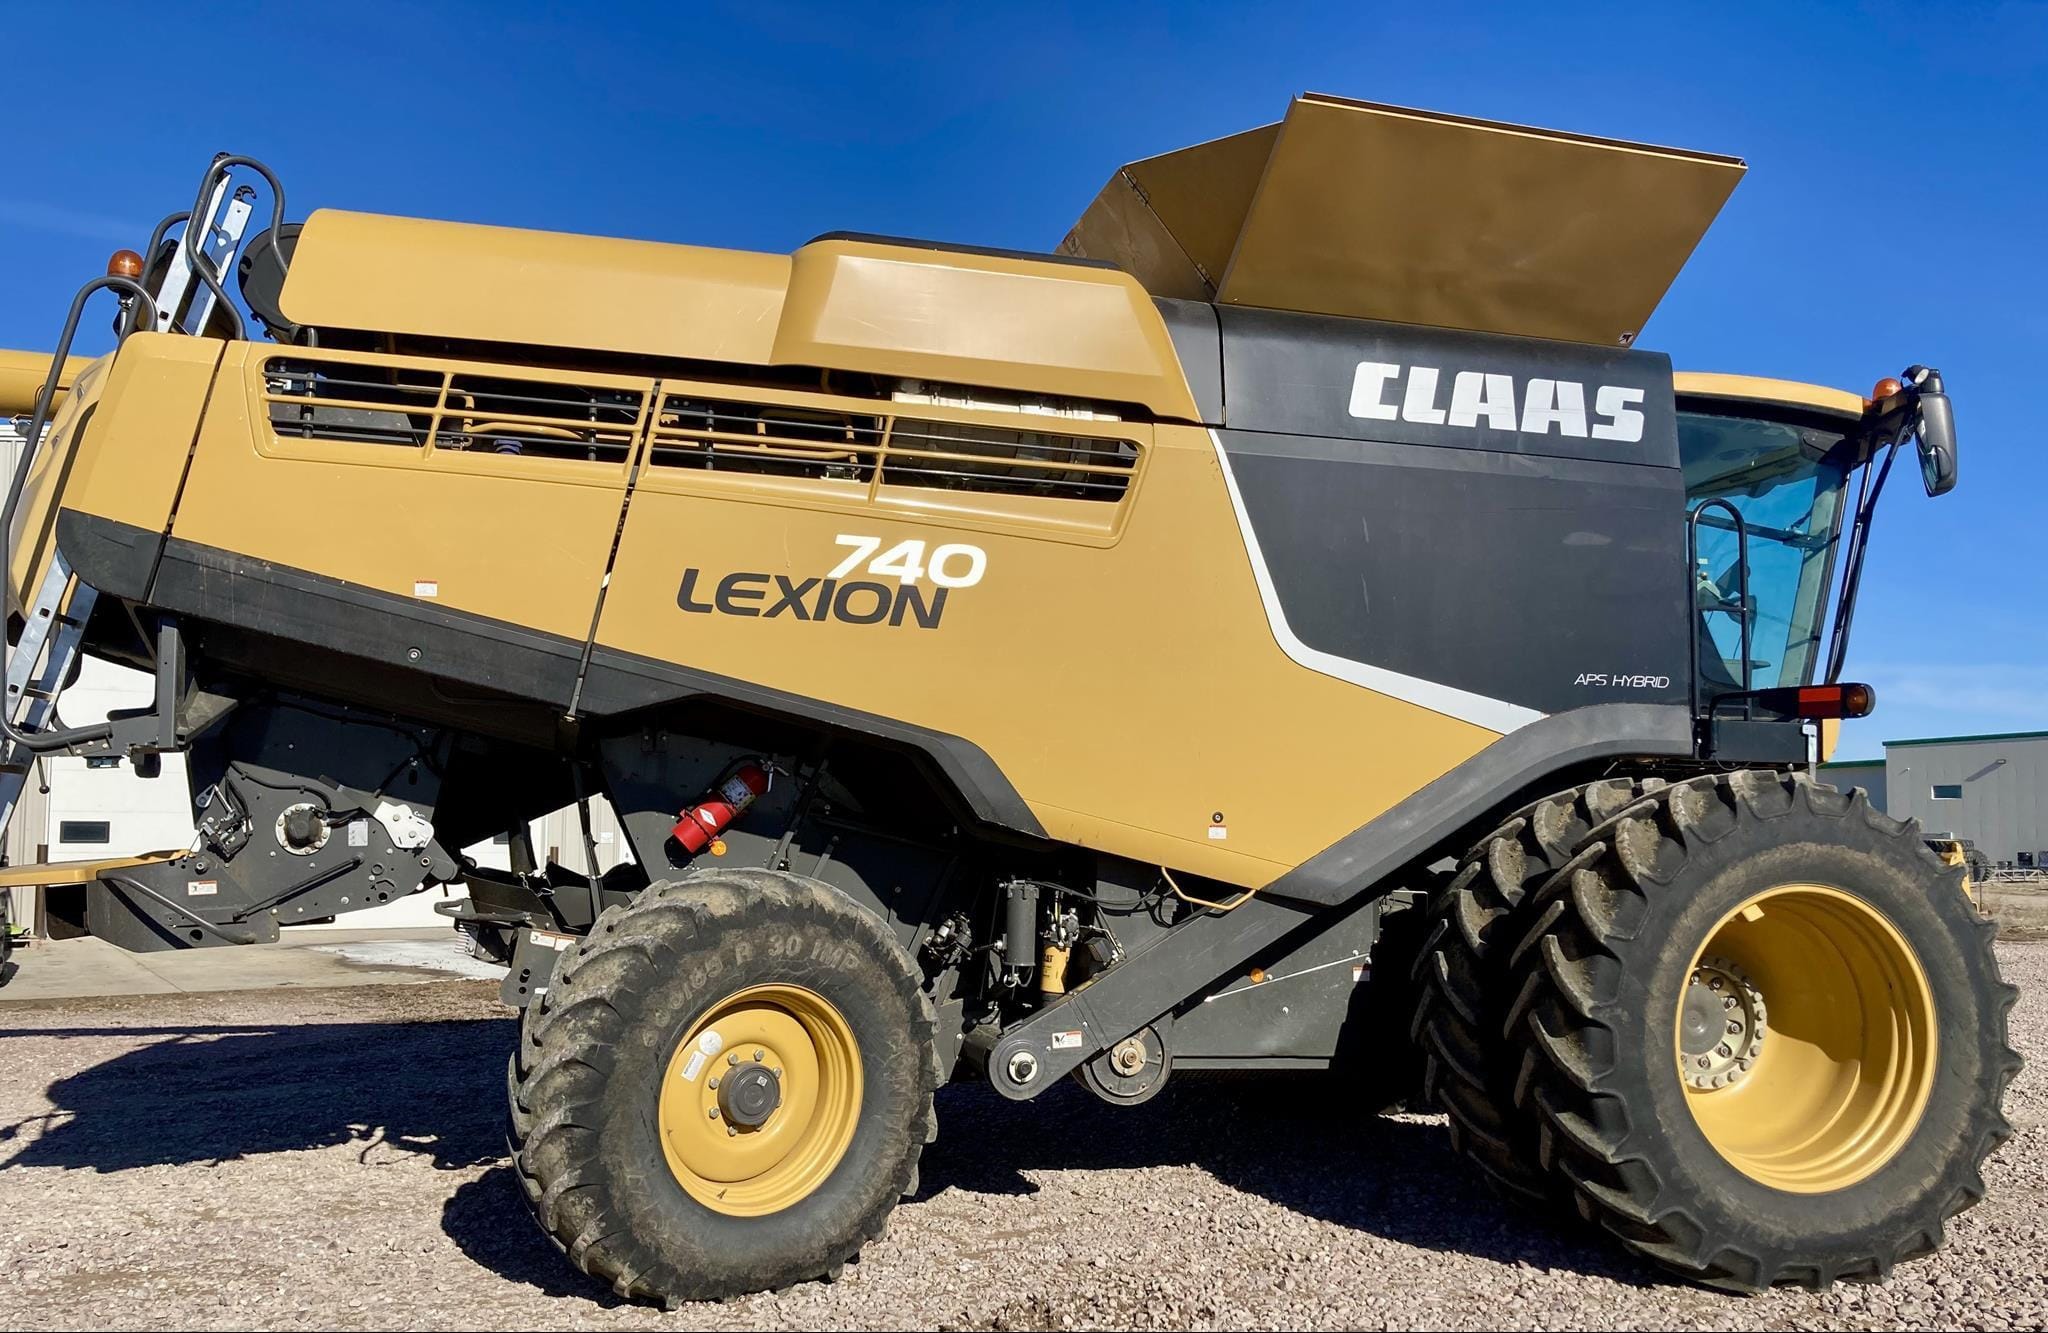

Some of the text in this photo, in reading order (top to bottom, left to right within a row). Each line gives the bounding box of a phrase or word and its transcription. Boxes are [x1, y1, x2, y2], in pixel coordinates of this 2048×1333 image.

[1348, 361, 1645, 442] CLAAS
[826, 534, 988, 589] 740
[676, 568, 949, 629] LEXION
[1574, 673, 1670, 689] APS HYBRID
[767, 934, 802, 957] 30
